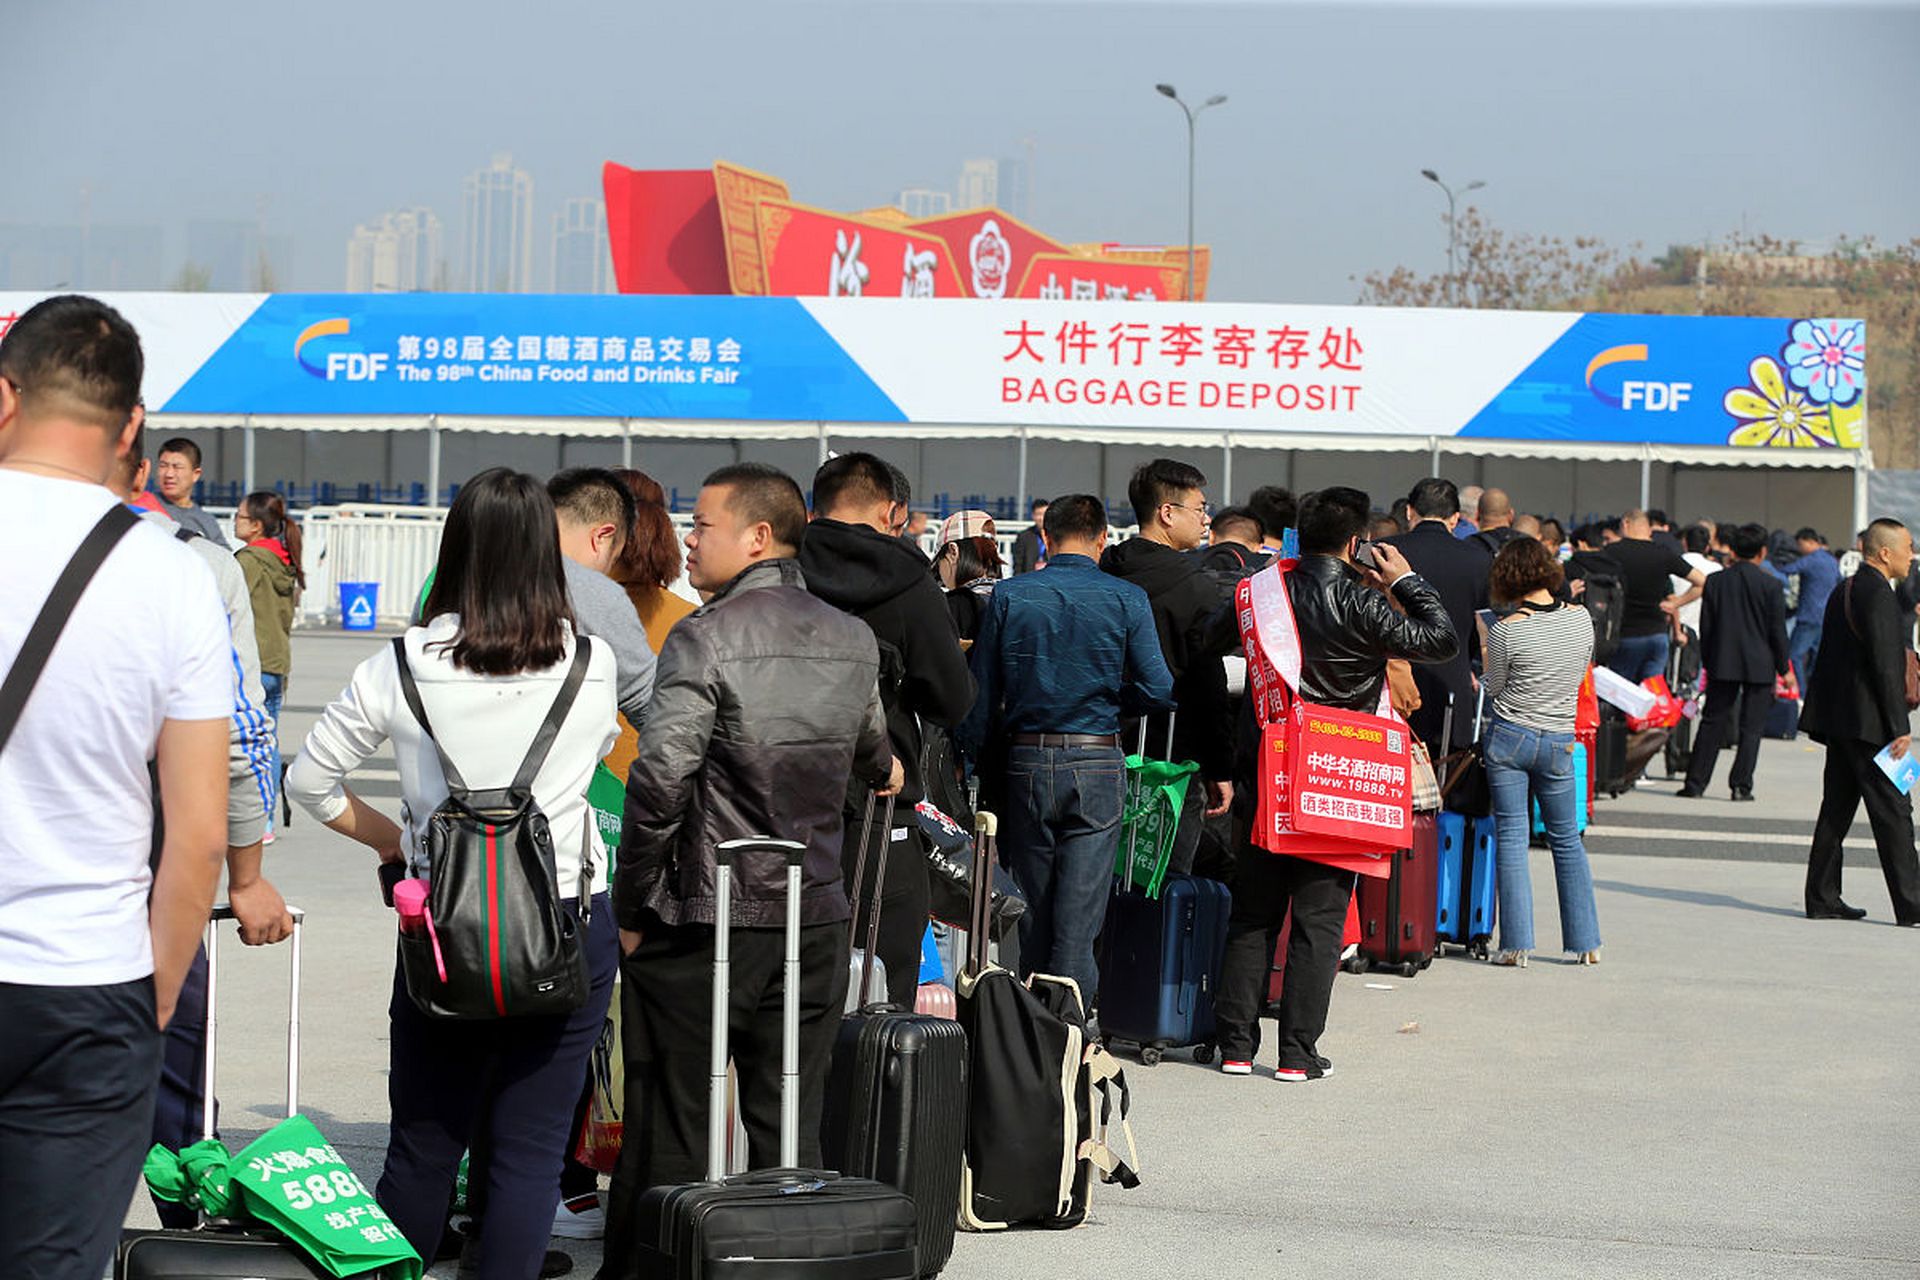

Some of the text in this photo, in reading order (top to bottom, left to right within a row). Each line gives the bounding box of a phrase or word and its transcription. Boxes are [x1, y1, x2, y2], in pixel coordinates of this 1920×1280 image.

[397, 334, 742, 363] 第98届全国糖酒商品交易会
[1003, 320, 1363, 371] 大件行李寄存处
[327, 353, 389, 381] FDF
[396, 364, 739, 384] The 98th China Food and Drinks Fair
[1001, 377, 1362, 411] BAGGAGE DEPOSIT
[1622, 381, 1692, 412] FDF
[1307, 751, 1406, 787] 中华名酒招商网
